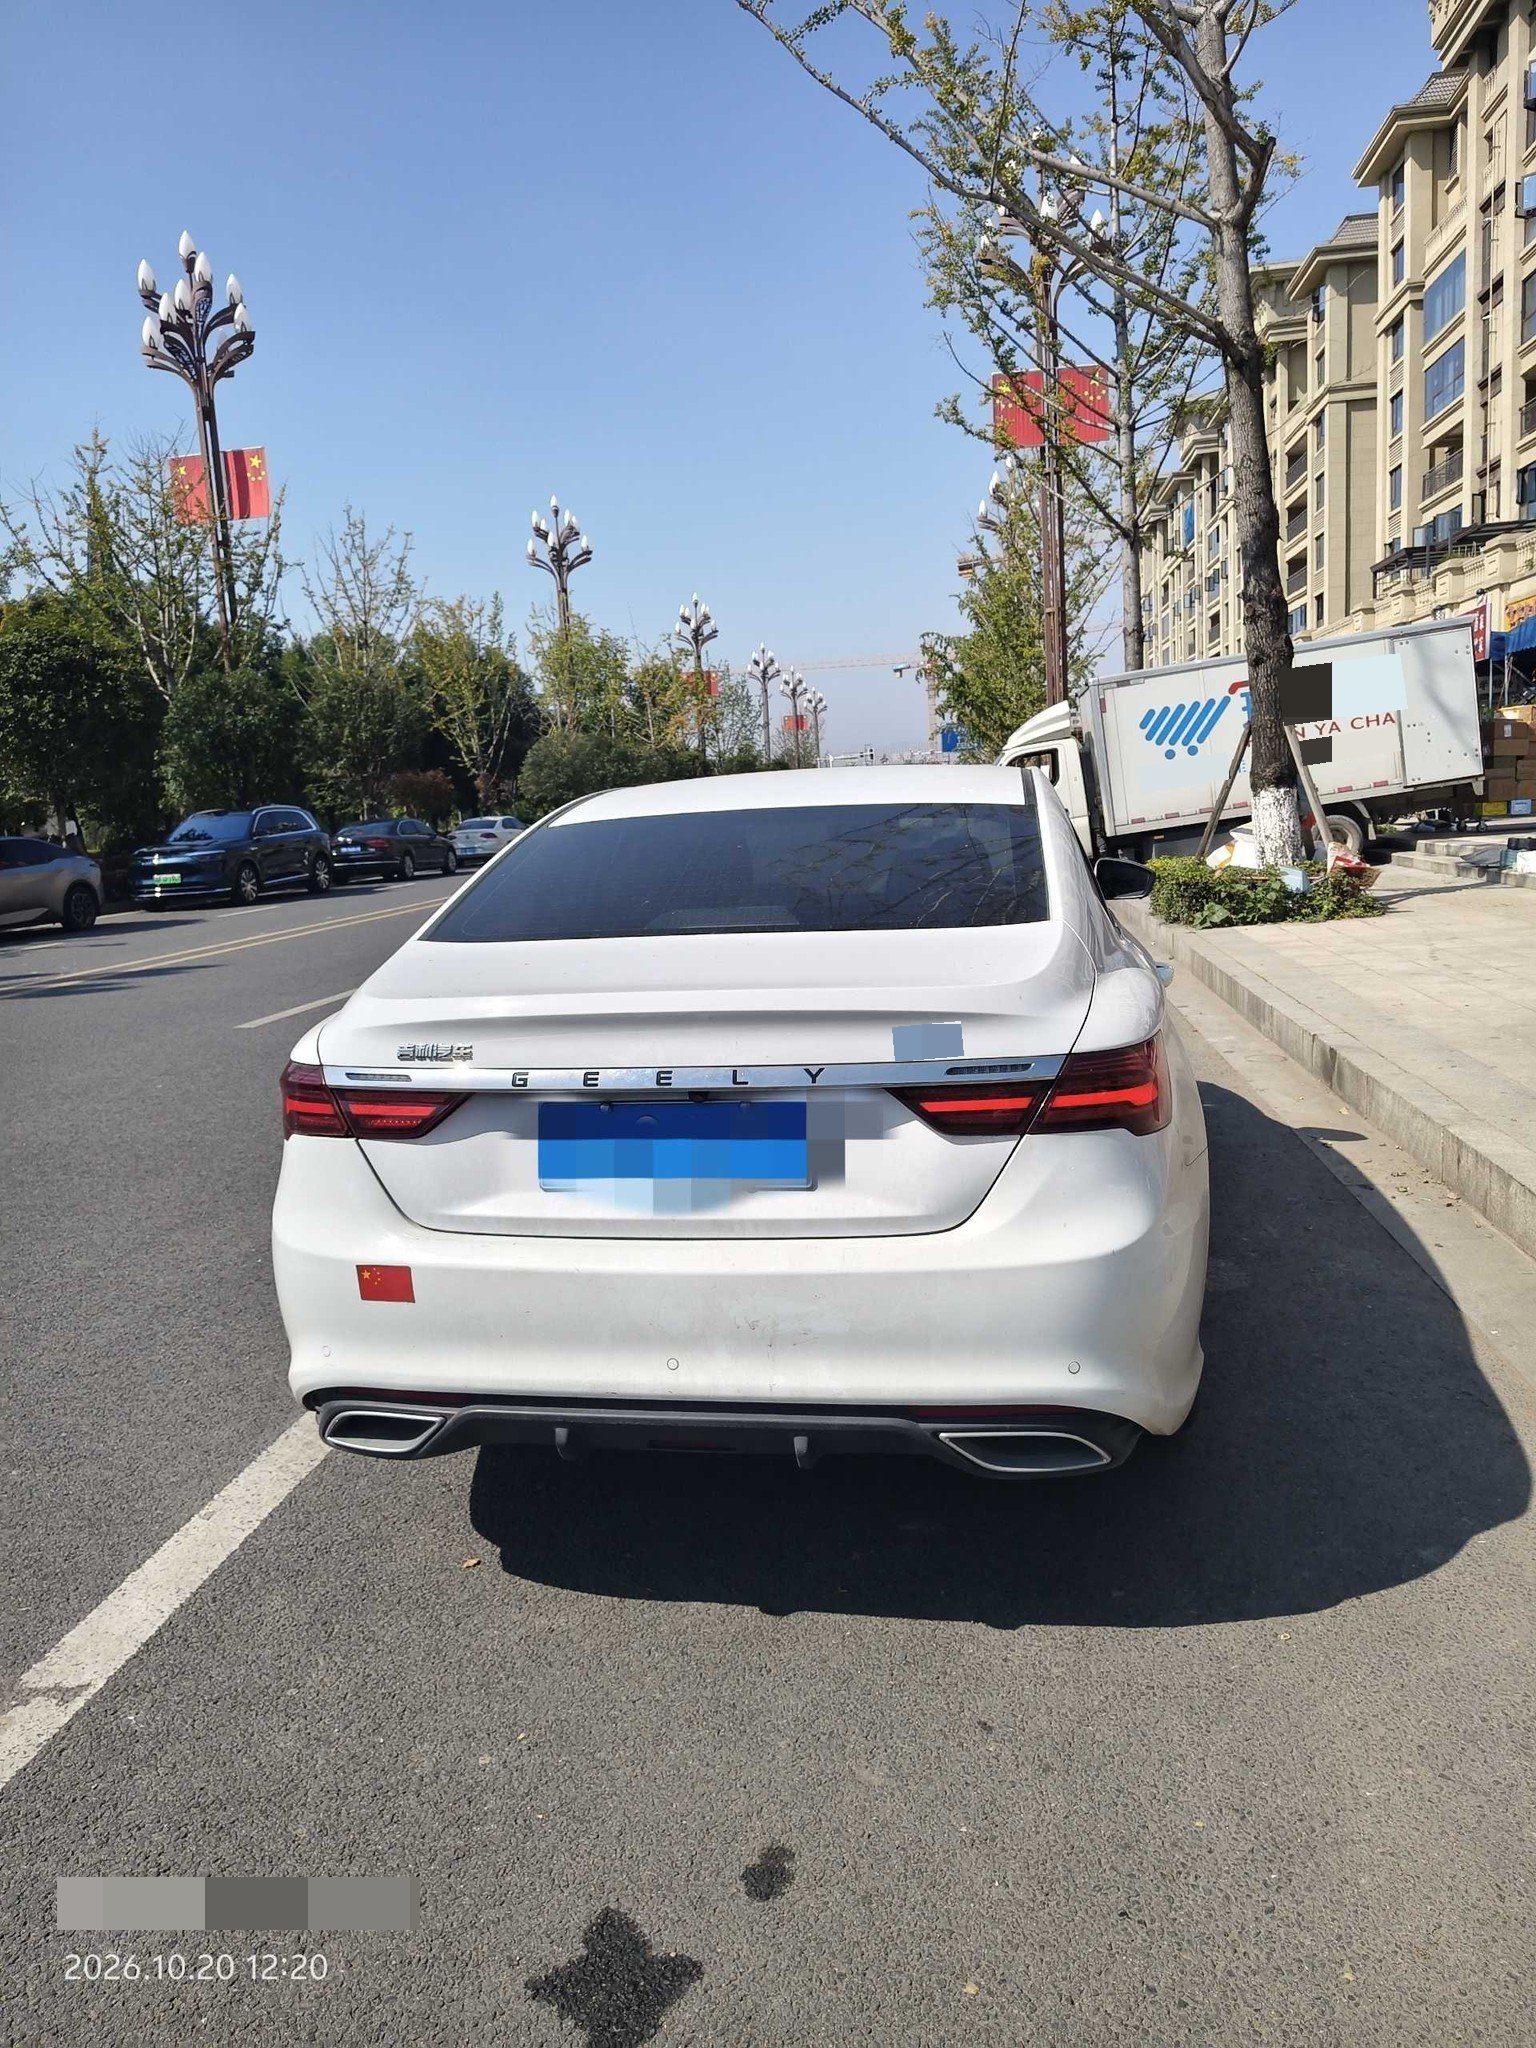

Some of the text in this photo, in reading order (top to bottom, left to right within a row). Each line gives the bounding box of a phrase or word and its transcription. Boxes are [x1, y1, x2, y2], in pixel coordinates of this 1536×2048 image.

[1315, 721, 1342, 736] YA
[1350, 711, 1396, 730] CHA
[511, 1067, 825, 1088] GEELY
